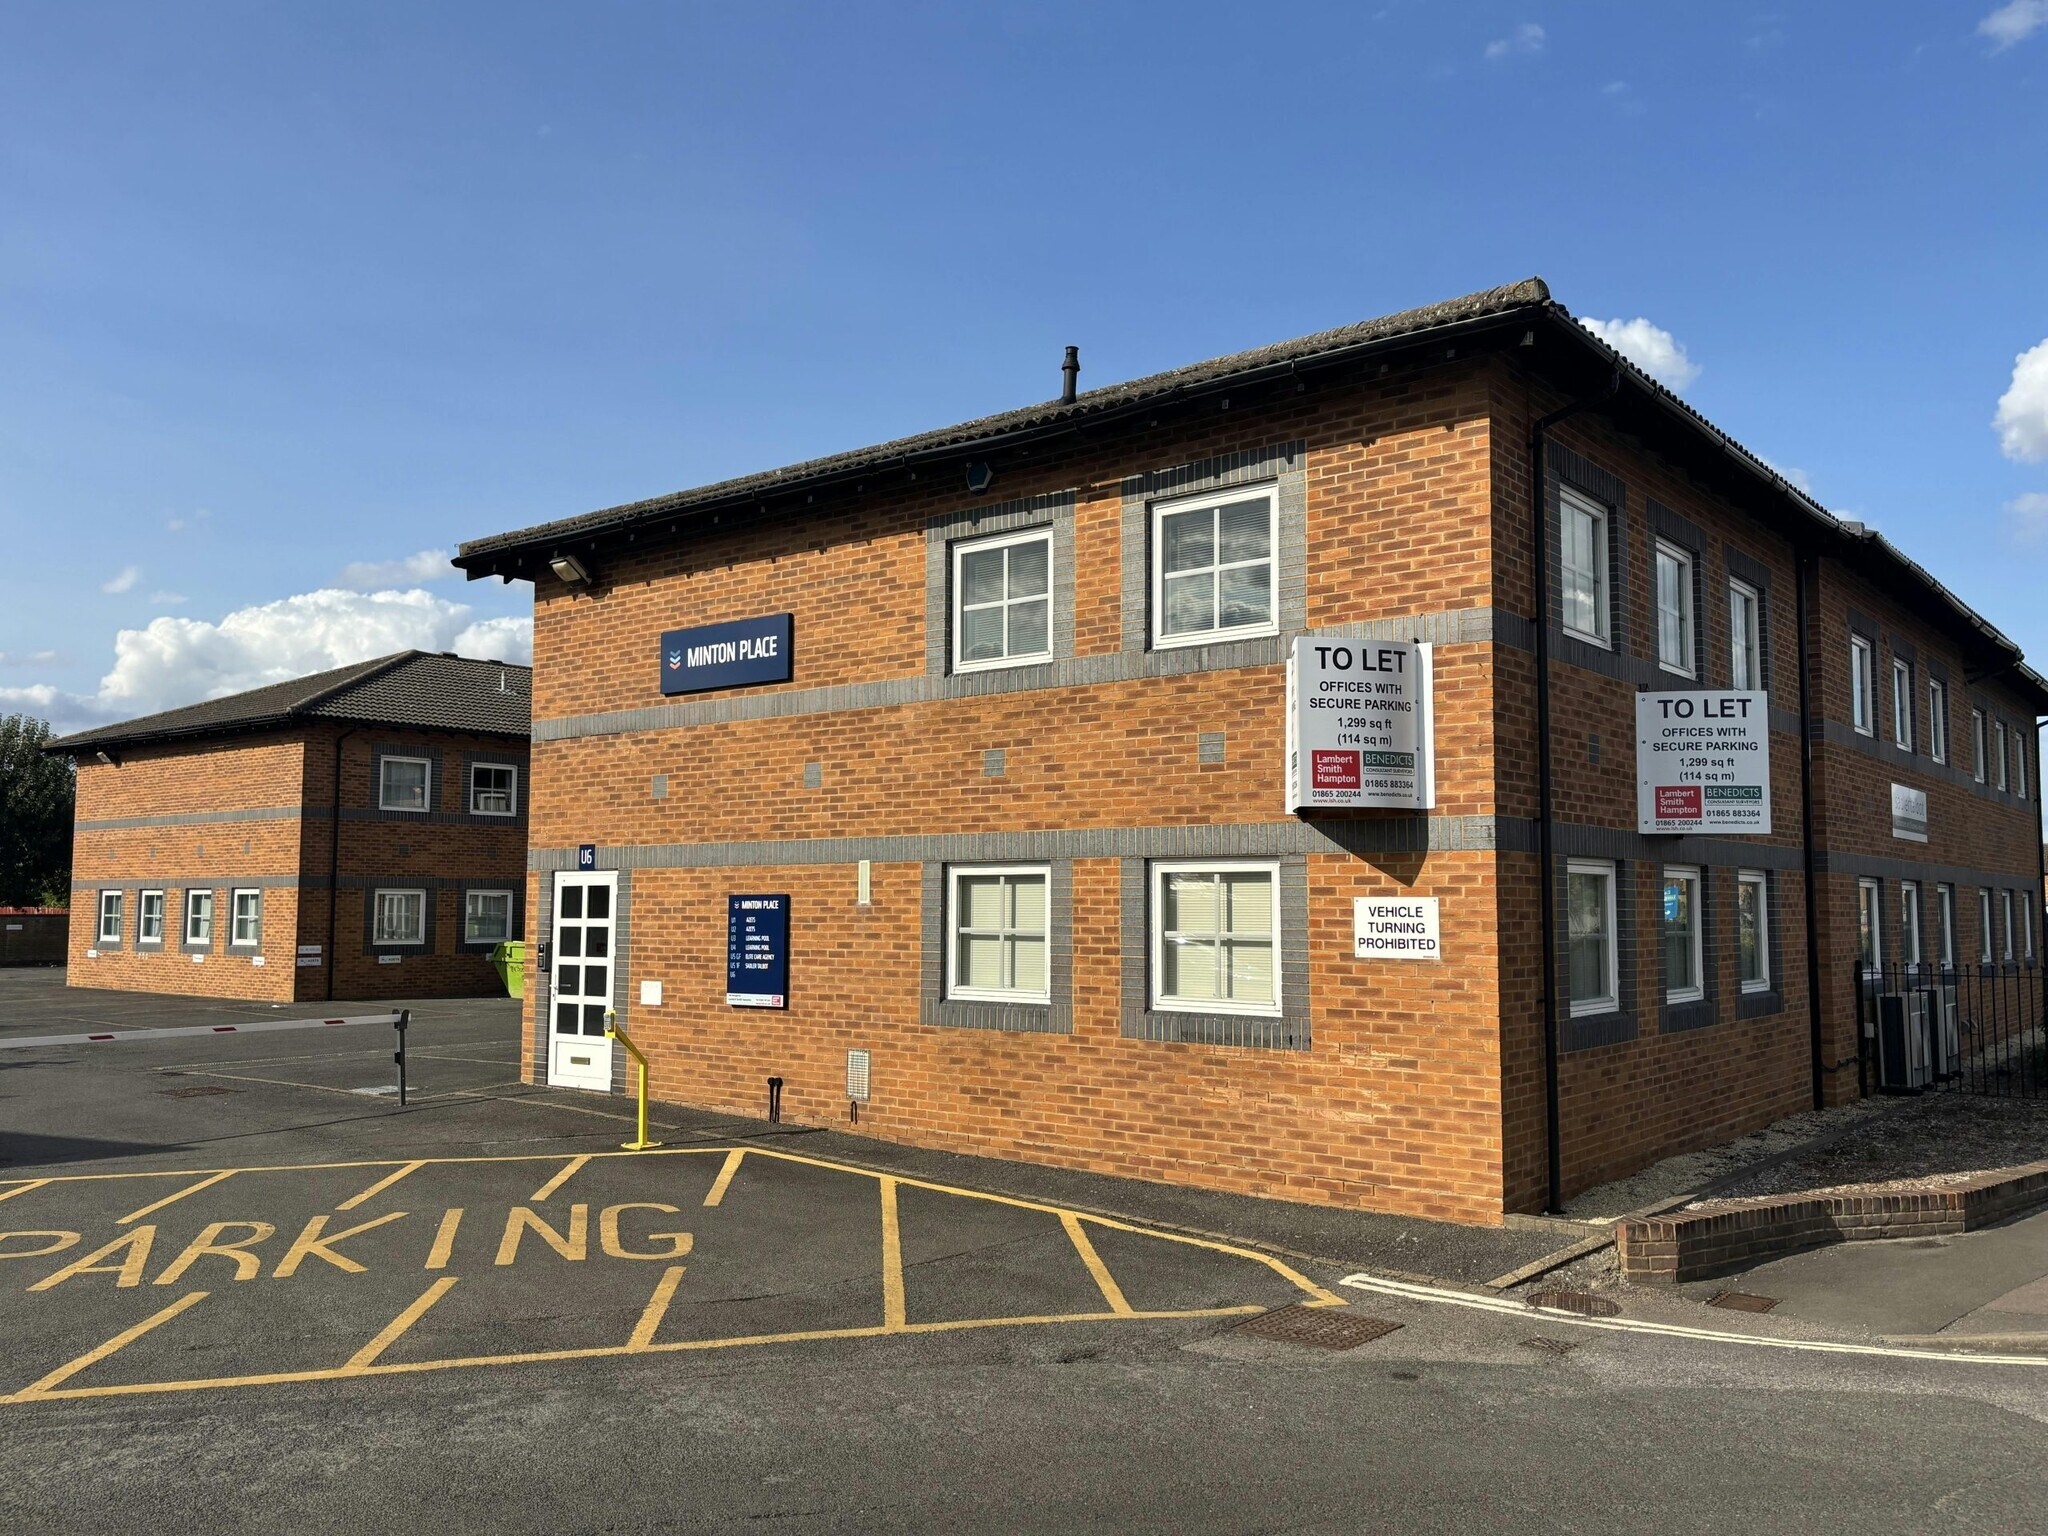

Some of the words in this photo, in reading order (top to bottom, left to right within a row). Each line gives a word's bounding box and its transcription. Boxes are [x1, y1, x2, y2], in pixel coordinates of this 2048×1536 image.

[688, 642, 735, 668] MINTON
[740, 636, 777, 660] PLACE
[1315, 647, 1352, 670] TO
[1363, 649, 1406, 673] LET
[1320, 681, 1371, 693] OFFICES
[1376, 683, 1401, 694] WITH
[1310, 698, 1361, 709] SECURE
[1365, 700, 1411, 712] PARKING
[1658, 699, 1694, 718] TO
[1704, 699, 1751, 718] LET
[1338, 718, 1366, 729] 1,299
[1370, 721, 1382, 730] sq
[1385, 719, 1392, 729] ft
[1662, 728, 1713, 737] OFFICES
[1717, 728, 1746, 736] WITH
[1338, 734, 1360, 745] (114
[1364, 737, 1376, 746] sq
[1380, 735, 1392, 747] m)
[1653, 742, 1702, 751] SECURE
[1706, 742, 1758, 751] PARKING
[1317, 754, 1352, 763] Lambert
[1365, 754, 1413, 765] BENEDICTS
[1680, 758, 1707, 767] 1,299
[1711, 760, 1724, 768] sq
[1727, 758, 1734, 766] ft
[1317, 765, 1342, 773] Smith
[1317, 774, 1355, 784] Hampton
[1680, 772, 1701, 782] (114
[1722, 772, 1735, 782] m)
[1365, 780, 1388, 788] 01865
[1390, 780, 1413, 789] 883364
[1707, 788, 1760, 797] BENEDICTS
[1661, 806, 1697, 814] Hampton
[581, 849, 592, 864] U6
[742, 901, 762, 909] MINTON
[763, 901, 779, 909] PLACE
[1369, 907, 1423, 917] VEHICLE
[1368, 922, 1425, 933] TURNING
[1359, 938, 1435, 950] PROHIBITED
